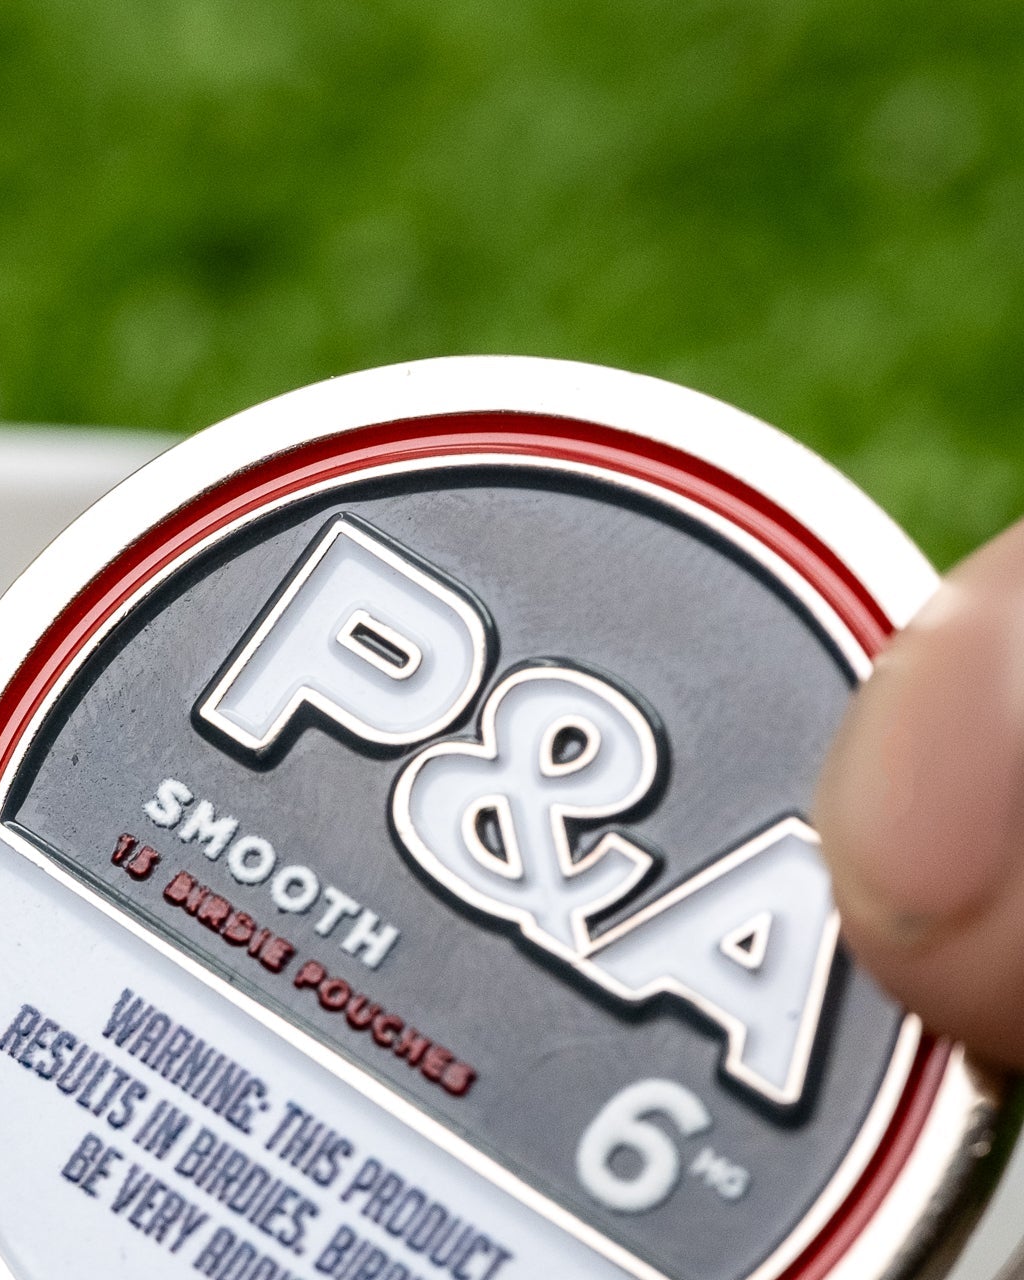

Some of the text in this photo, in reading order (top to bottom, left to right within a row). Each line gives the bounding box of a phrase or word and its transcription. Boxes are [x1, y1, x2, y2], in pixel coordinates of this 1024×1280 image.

[143, 777, 400, 970] SMOOTH
[196, 510, 844, 1110] P&A
[111, 832, 478, 1098] 15 BIRDIE POUCHES
[102, 987, 270, 1135] WARNING:
[264, 1100, 355, 1189] THIS
[132, 1099, 193, 1160] IN
[174, 1125, 320, 1256] BIRDIES.
[577, 1076, 751, 1213] 6 MG
[60, 1131, 125, 1199] BE
[110, 1163, 211, 1254] VERY
